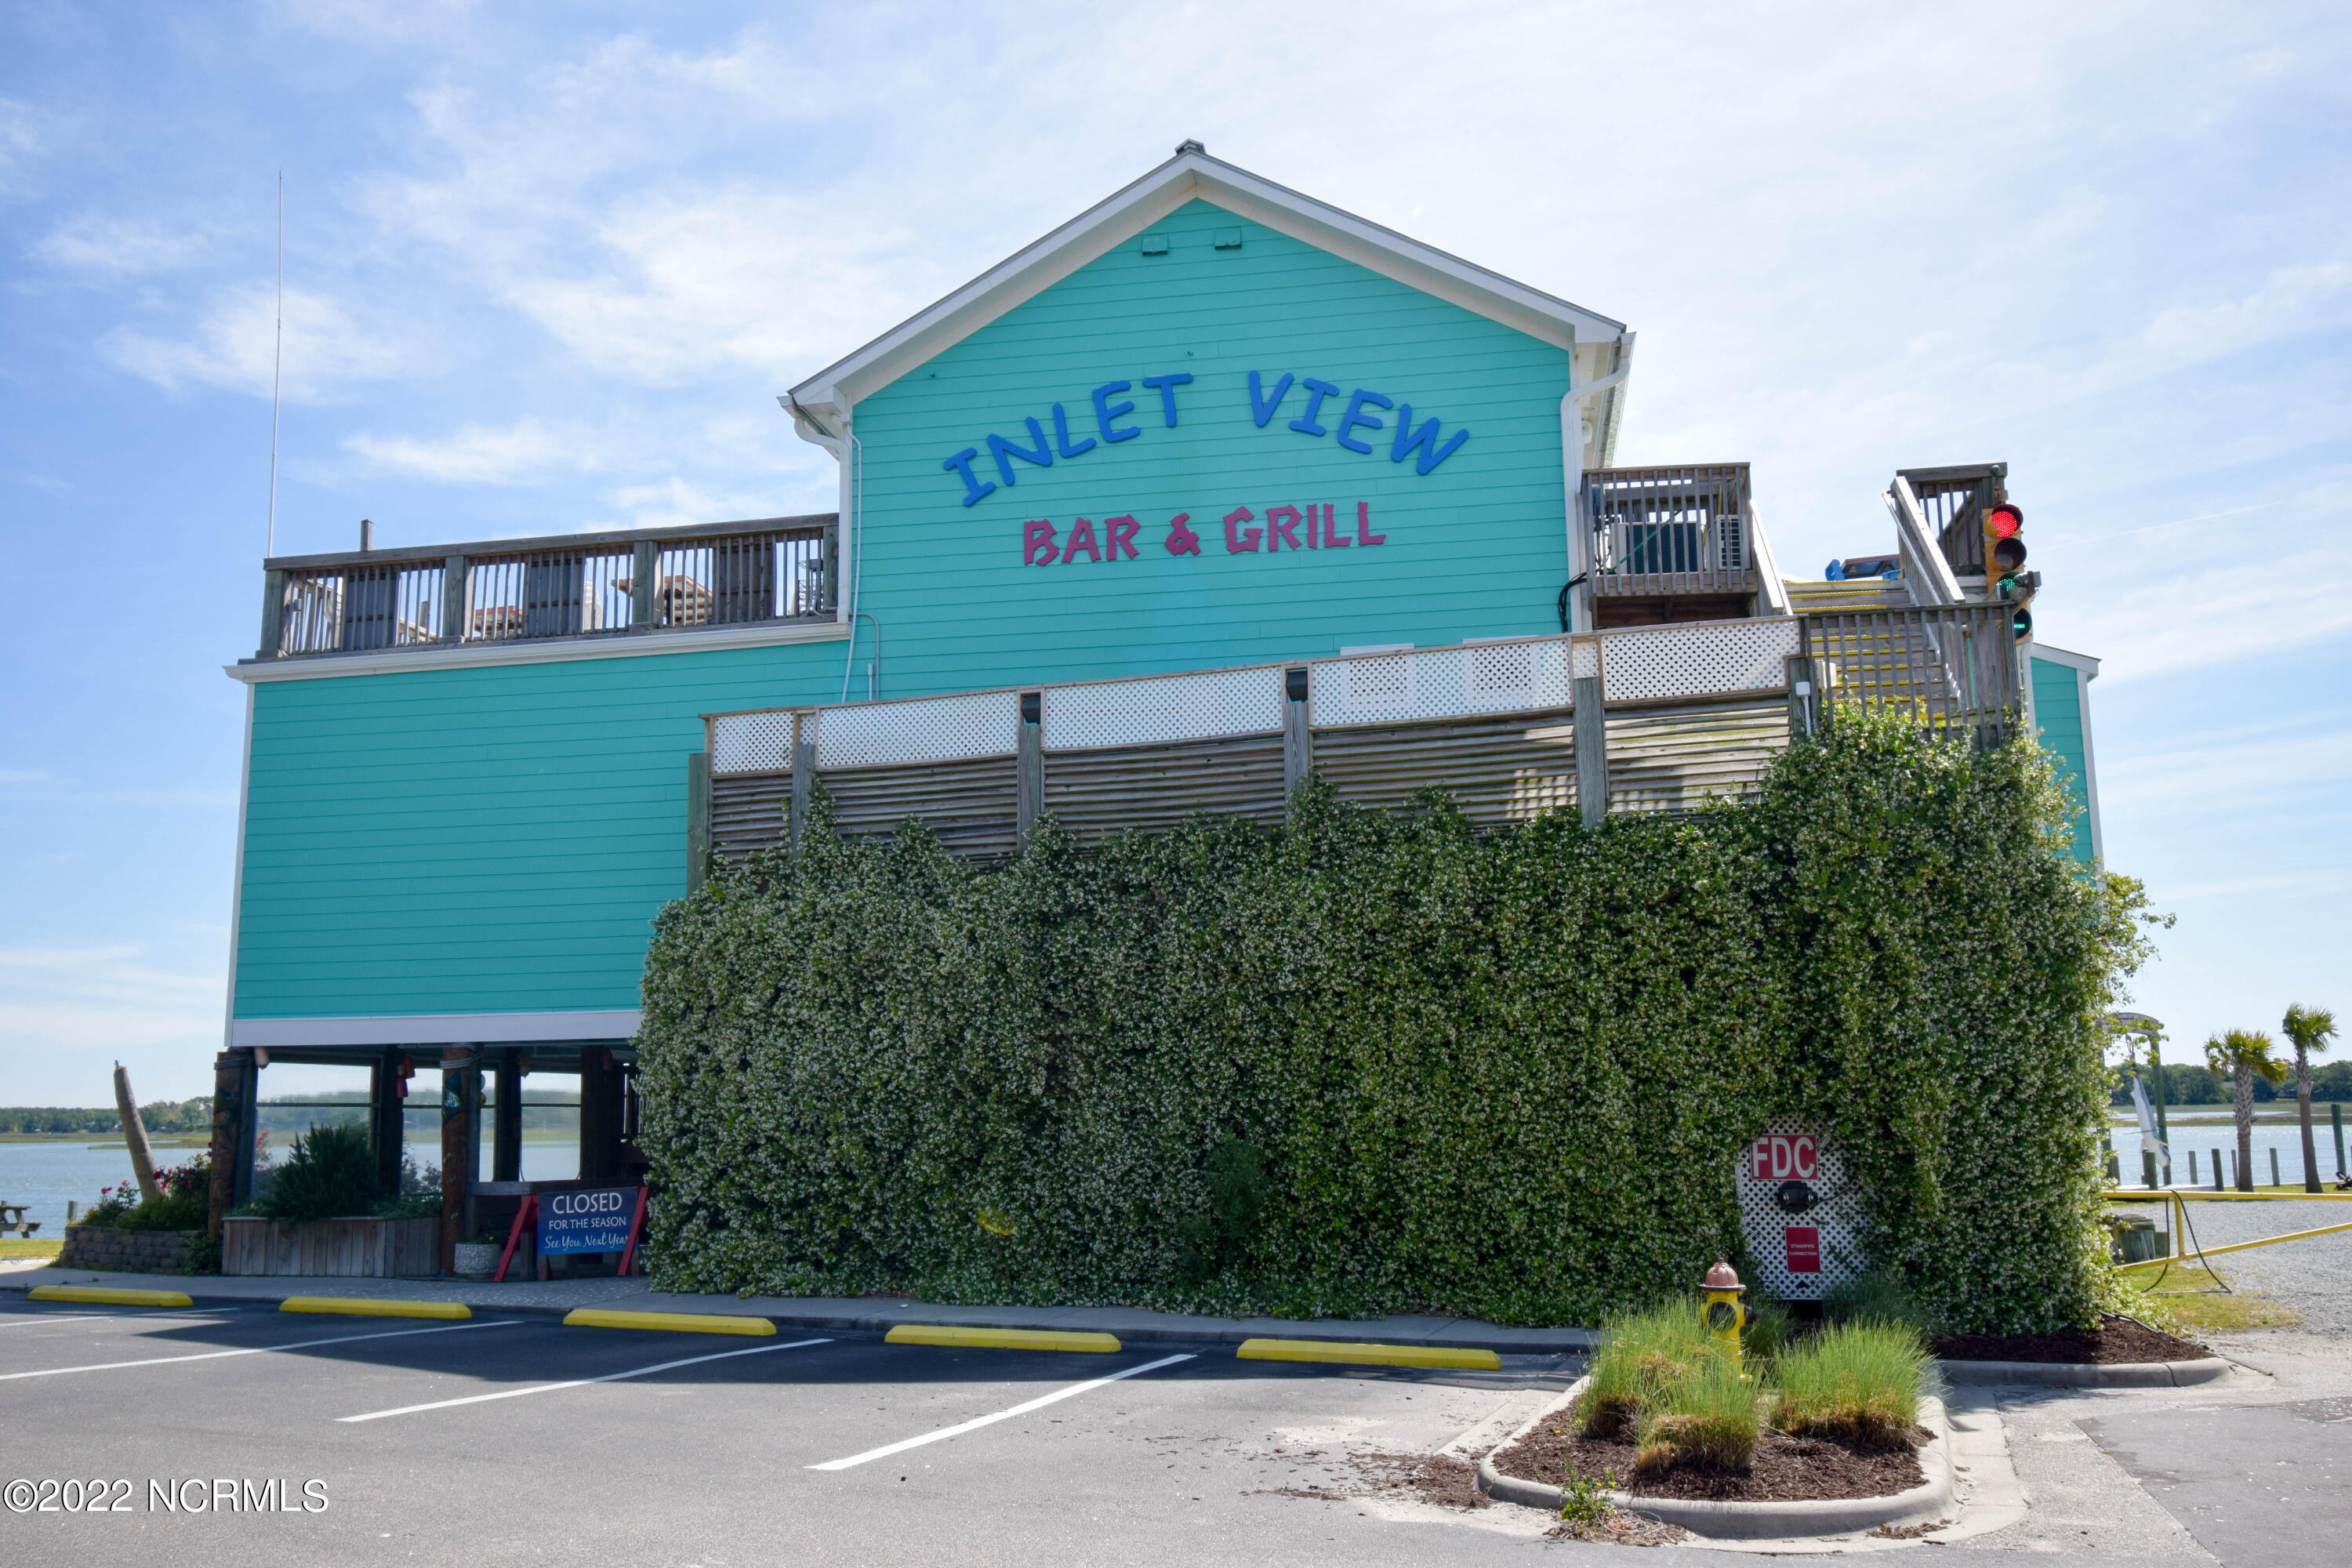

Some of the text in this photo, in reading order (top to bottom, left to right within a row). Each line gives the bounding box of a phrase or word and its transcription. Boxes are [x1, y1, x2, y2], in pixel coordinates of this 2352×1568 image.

[943, 370, 1469, 508] INLET VIEW
[1023, 501, 1387, 566] BAR & GRILL
[1752, 1135, 1815, 1178] FDC
[552, 1192, 622, 1214] CLOSED
[549, 1216, 626, 1230] FOR THE SEASON
[544, 1231, 629, 1251] See You Next Year
